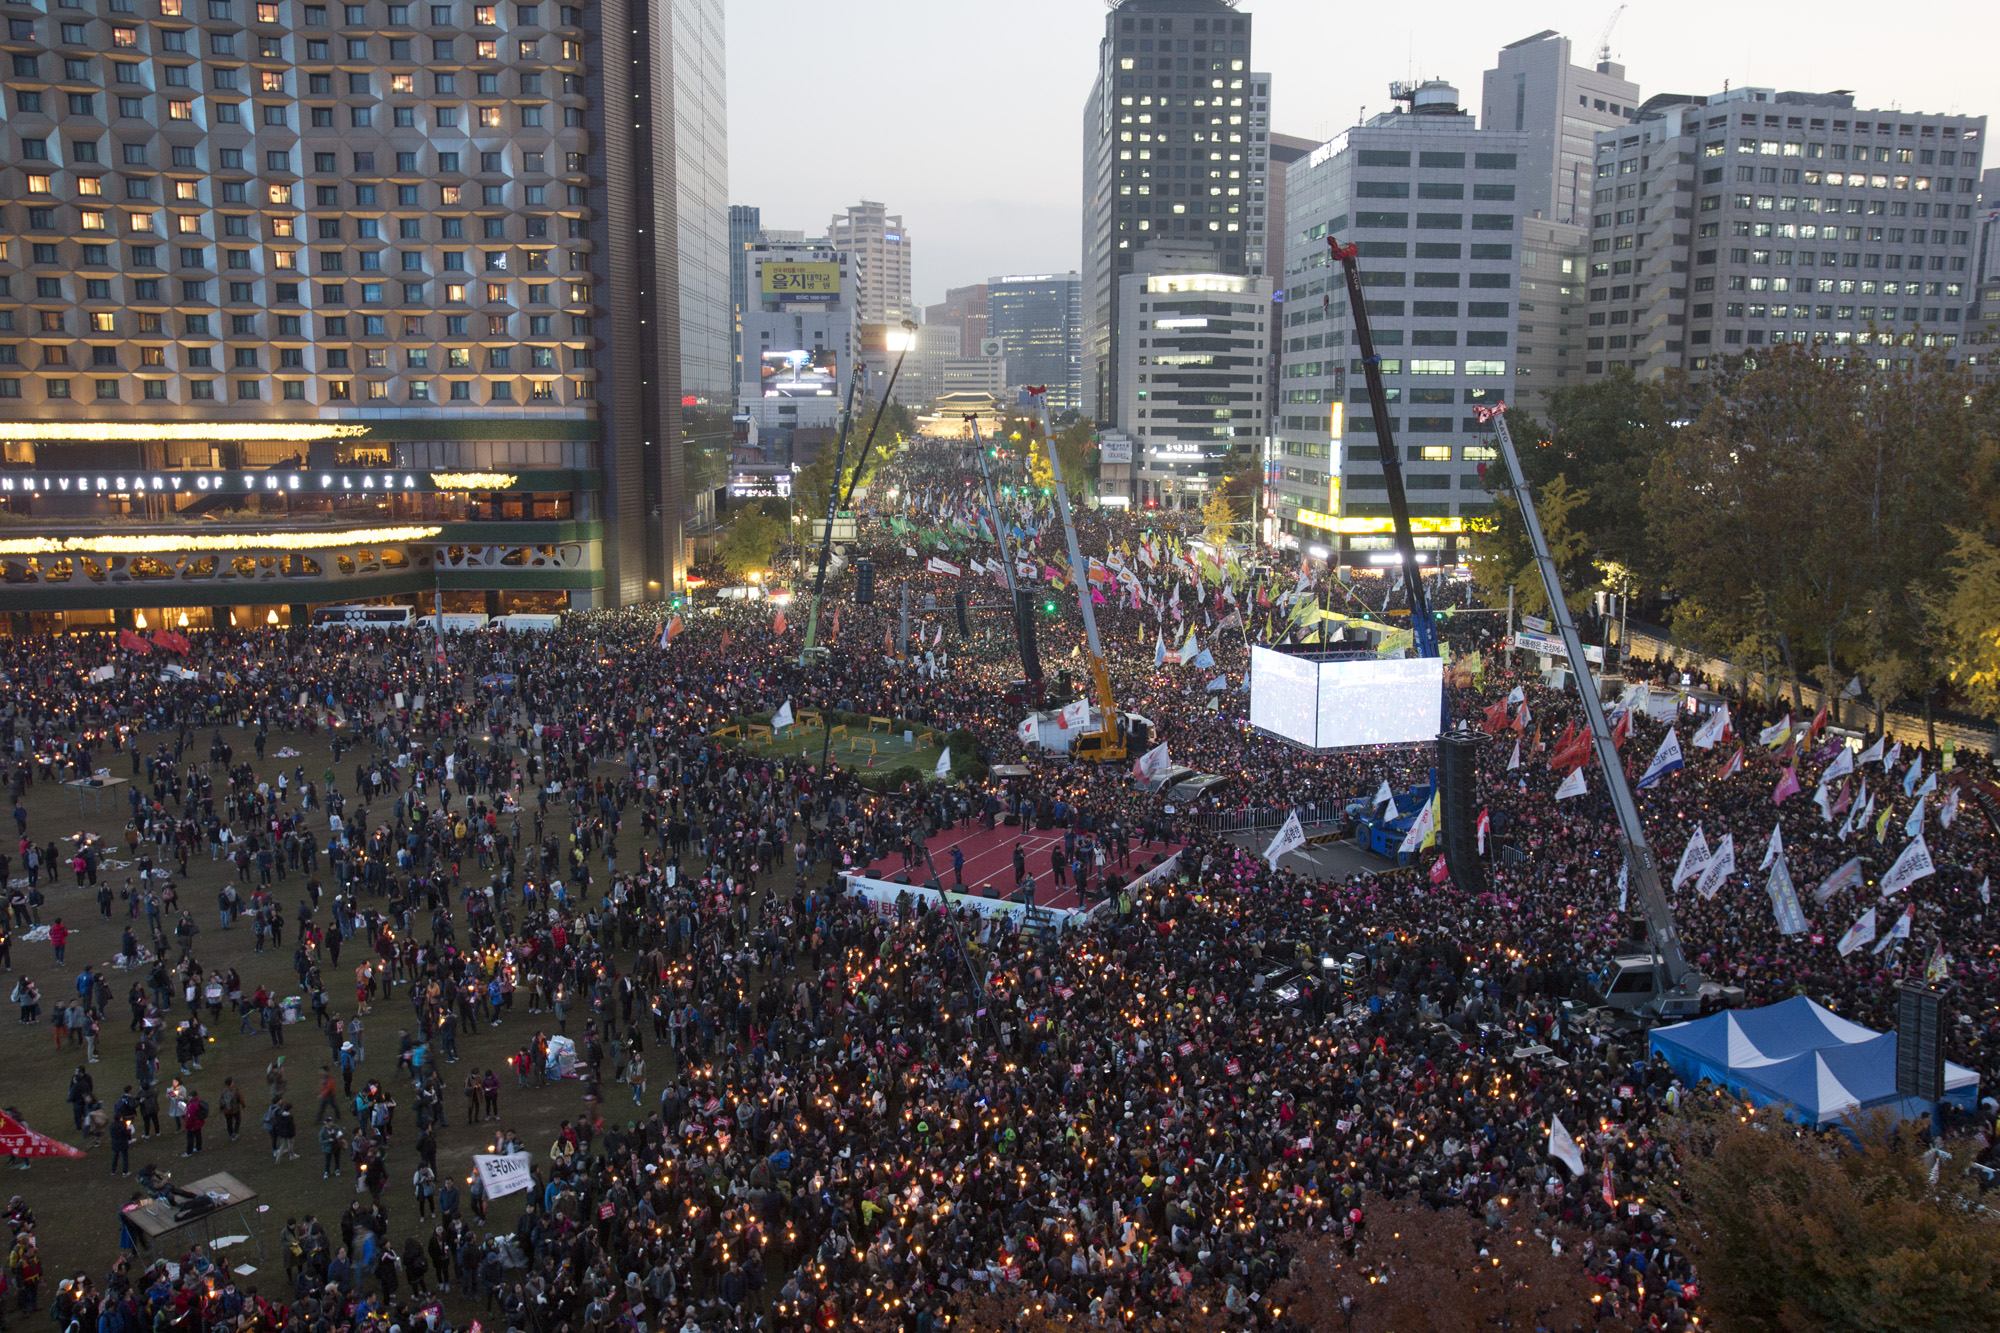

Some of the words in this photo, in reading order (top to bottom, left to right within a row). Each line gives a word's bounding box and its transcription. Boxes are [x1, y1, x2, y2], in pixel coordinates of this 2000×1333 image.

[772, 273, 806, 289] 을지
[197, 477, 223, 490] OF
[244, 476, 300, 489] THE
[322, 475, 415, 488] PLAZA
[1519, 638, 1541, 650] 대통령은
[1543, 642, 1566, 655] 국정에서
[1643, 852, 1652, 870] KATO
